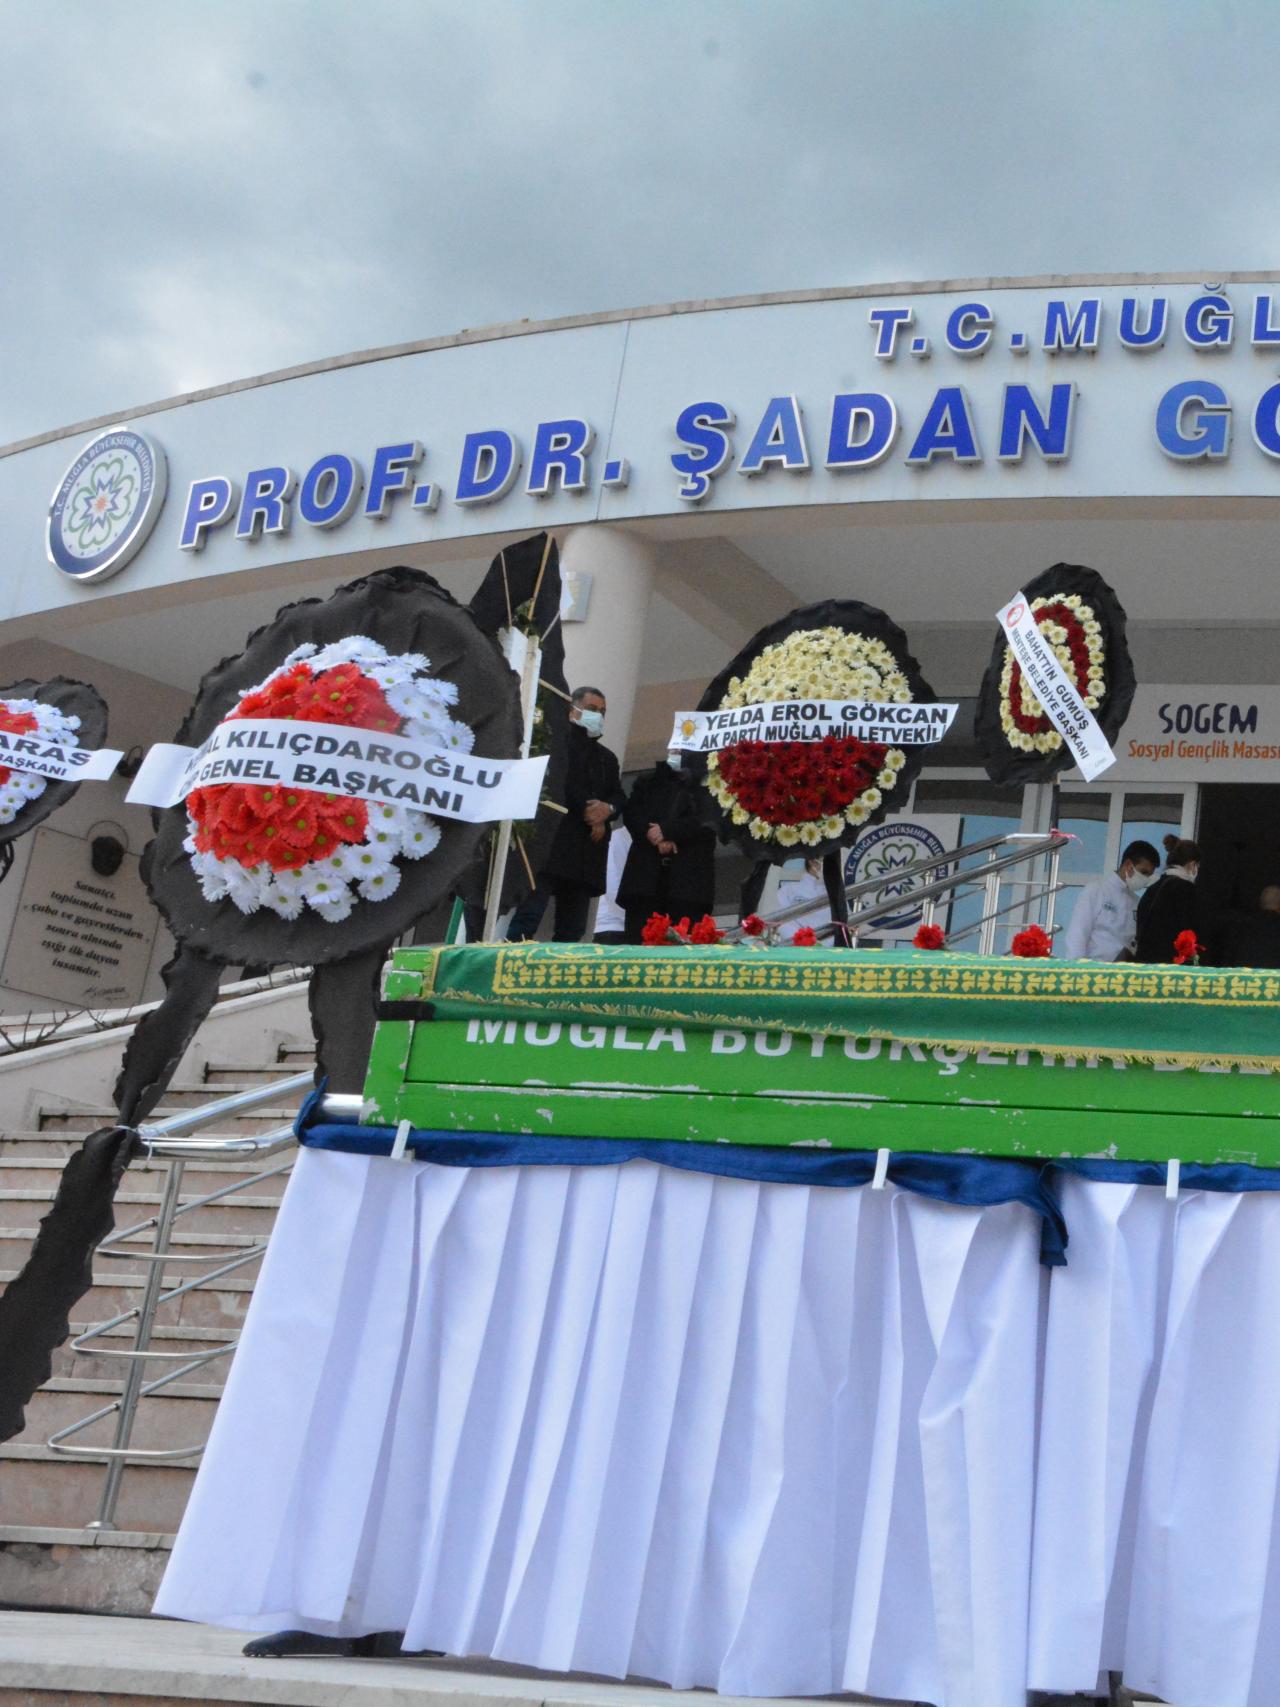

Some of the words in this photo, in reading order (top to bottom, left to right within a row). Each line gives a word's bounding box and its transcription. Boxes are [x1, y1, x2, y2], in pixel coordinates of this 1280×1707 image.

[669, 382, 1079, 502] ŞADAN
[1025, 629, 1057, 681] BAHATTİN
[1055, 684, 1090, 731] GÜMÜŞ
[700, 732, 718, 750] AK
[722, 722, 761, 747] PARTİ
[764, 721, 822, 742] MUĞLA
[705, 707, 764, 731] YELDA
[771, 704, 833, 722] EROL
[840, 703, 948, 724] GÖKCAN
[1027, 664, 1057, 712] BELEDİYE
[1056, 712, 1090, 760] BAŞKANI
[1158, 702, 1258, 734] SOGEM
[226, 730, 503, 789] KILIÇDAROĞLU
[1128, 739, 1174, 762] Sosyal
[1178, 740, 1229, 763] Gençlik
[200, 759, 281, 780] GENEL
[293, 764, 464, 814] BAŞKANI
